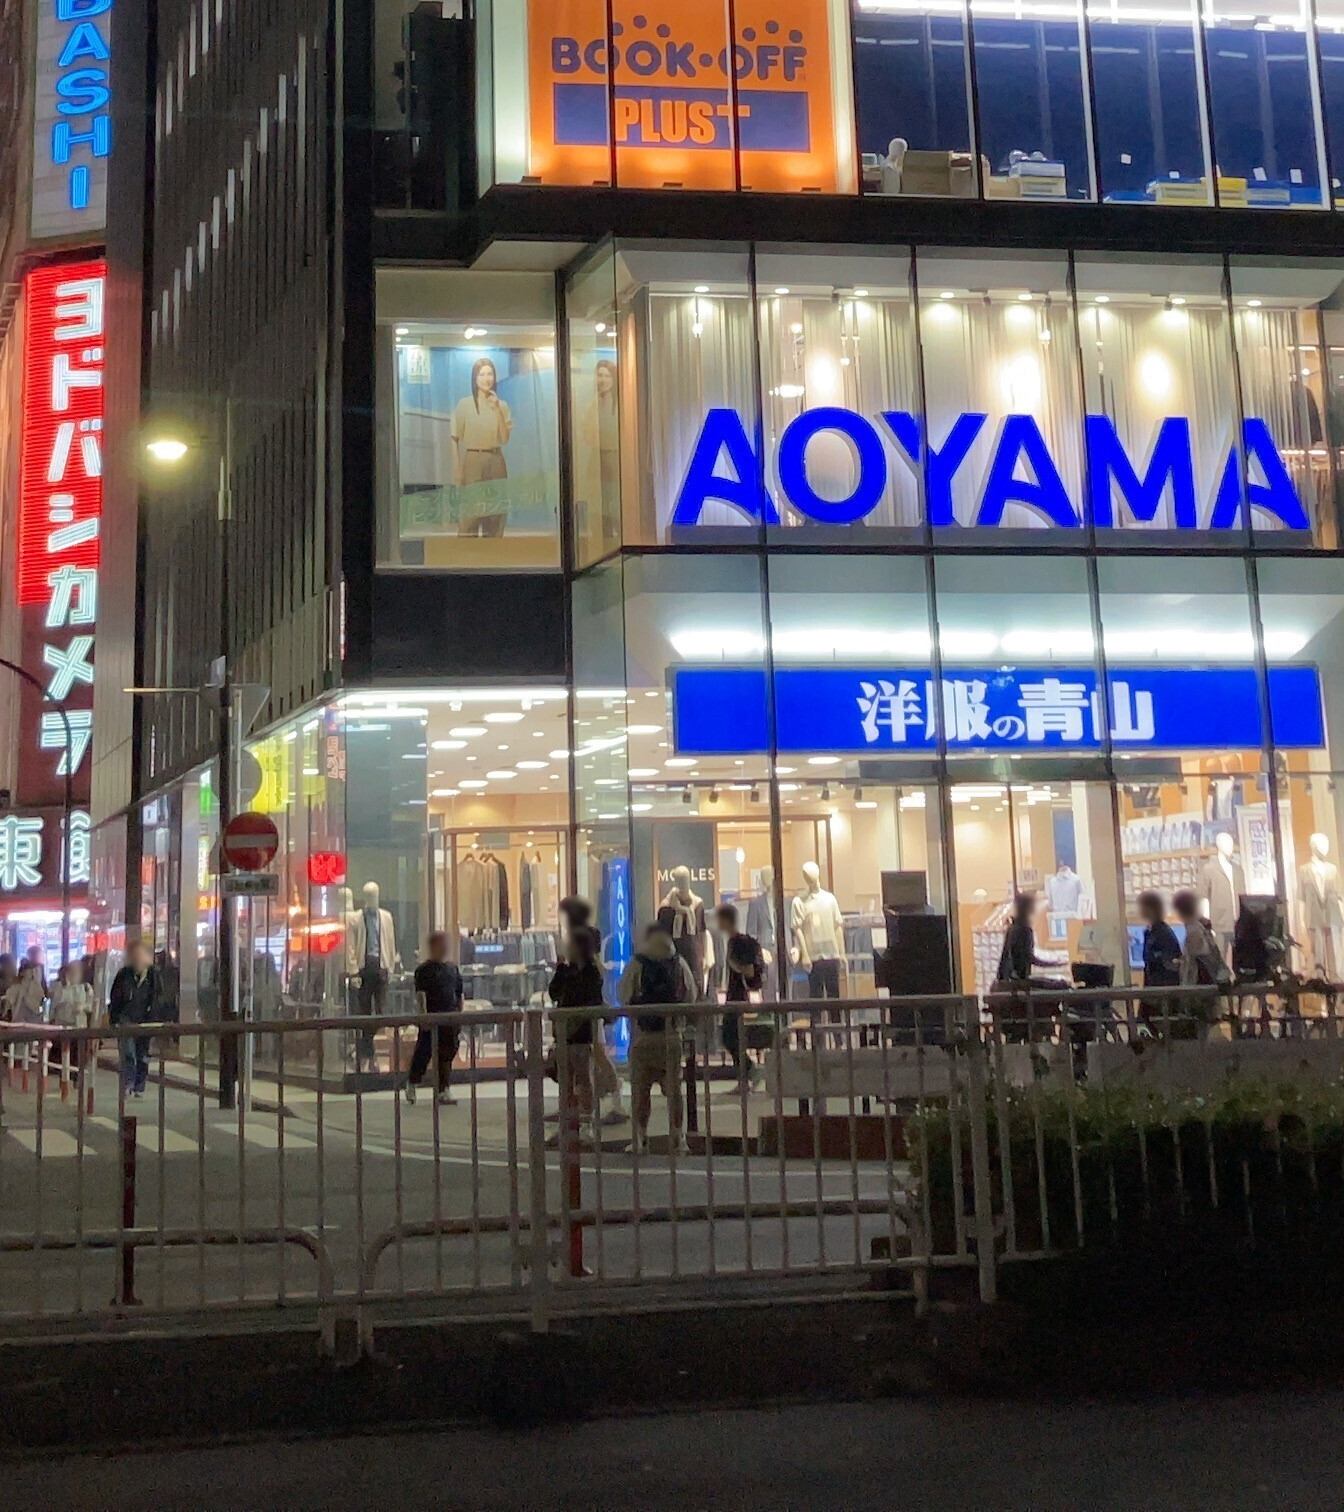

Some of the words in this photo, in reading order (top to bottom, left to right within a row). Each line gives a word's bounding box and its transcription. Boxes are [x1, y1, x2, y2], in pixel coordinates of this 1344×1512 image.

[39, 277, 104, 776] ヨドバシカメラ
[672, 407, 1311, 530] AOYAMA
[857, 680, 1155, 741] 洋服の青山
[617, 875, 627, 1041] AOYA
